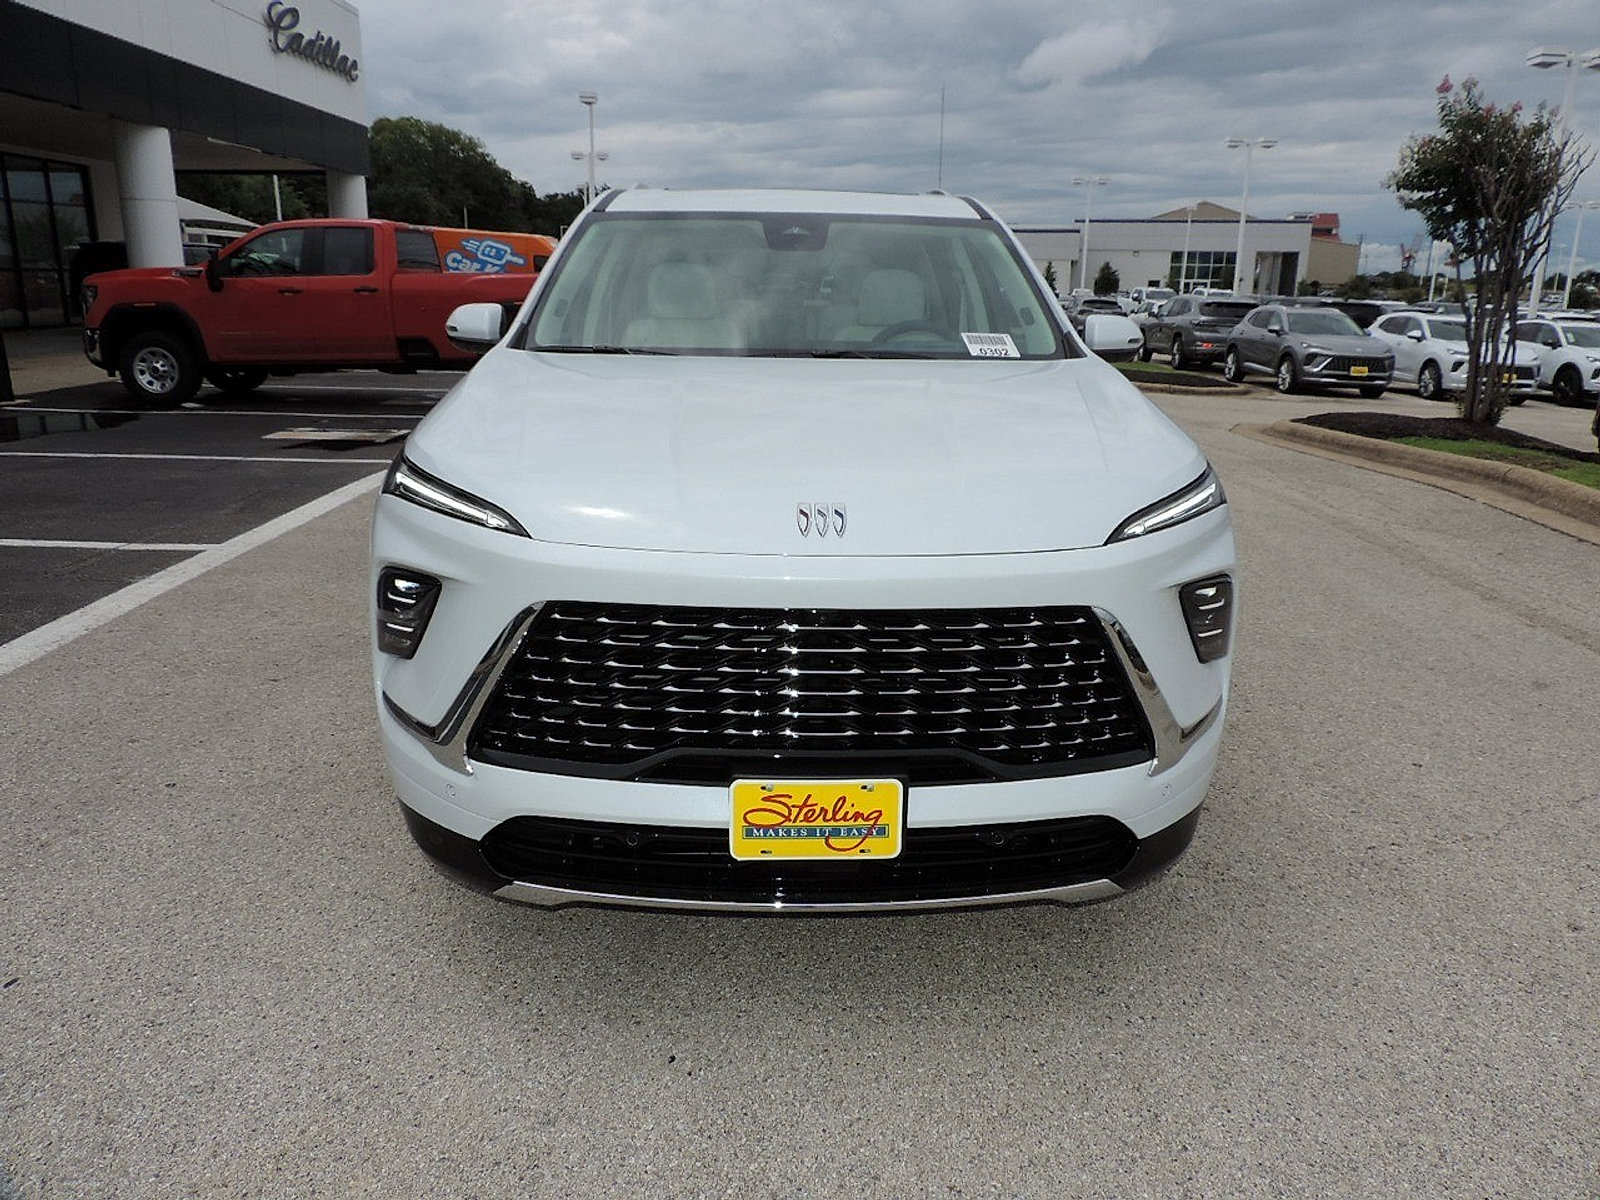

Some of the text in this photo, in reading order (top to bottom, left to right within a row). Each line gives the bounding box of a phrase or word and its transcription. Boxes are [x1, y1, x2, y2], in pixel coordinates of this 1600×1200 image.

[267, 1, 359, 82] Cadillac
[743, 793, 883, 853] Sterling
[752, 827, 879, 837] MAKES IT EASY
